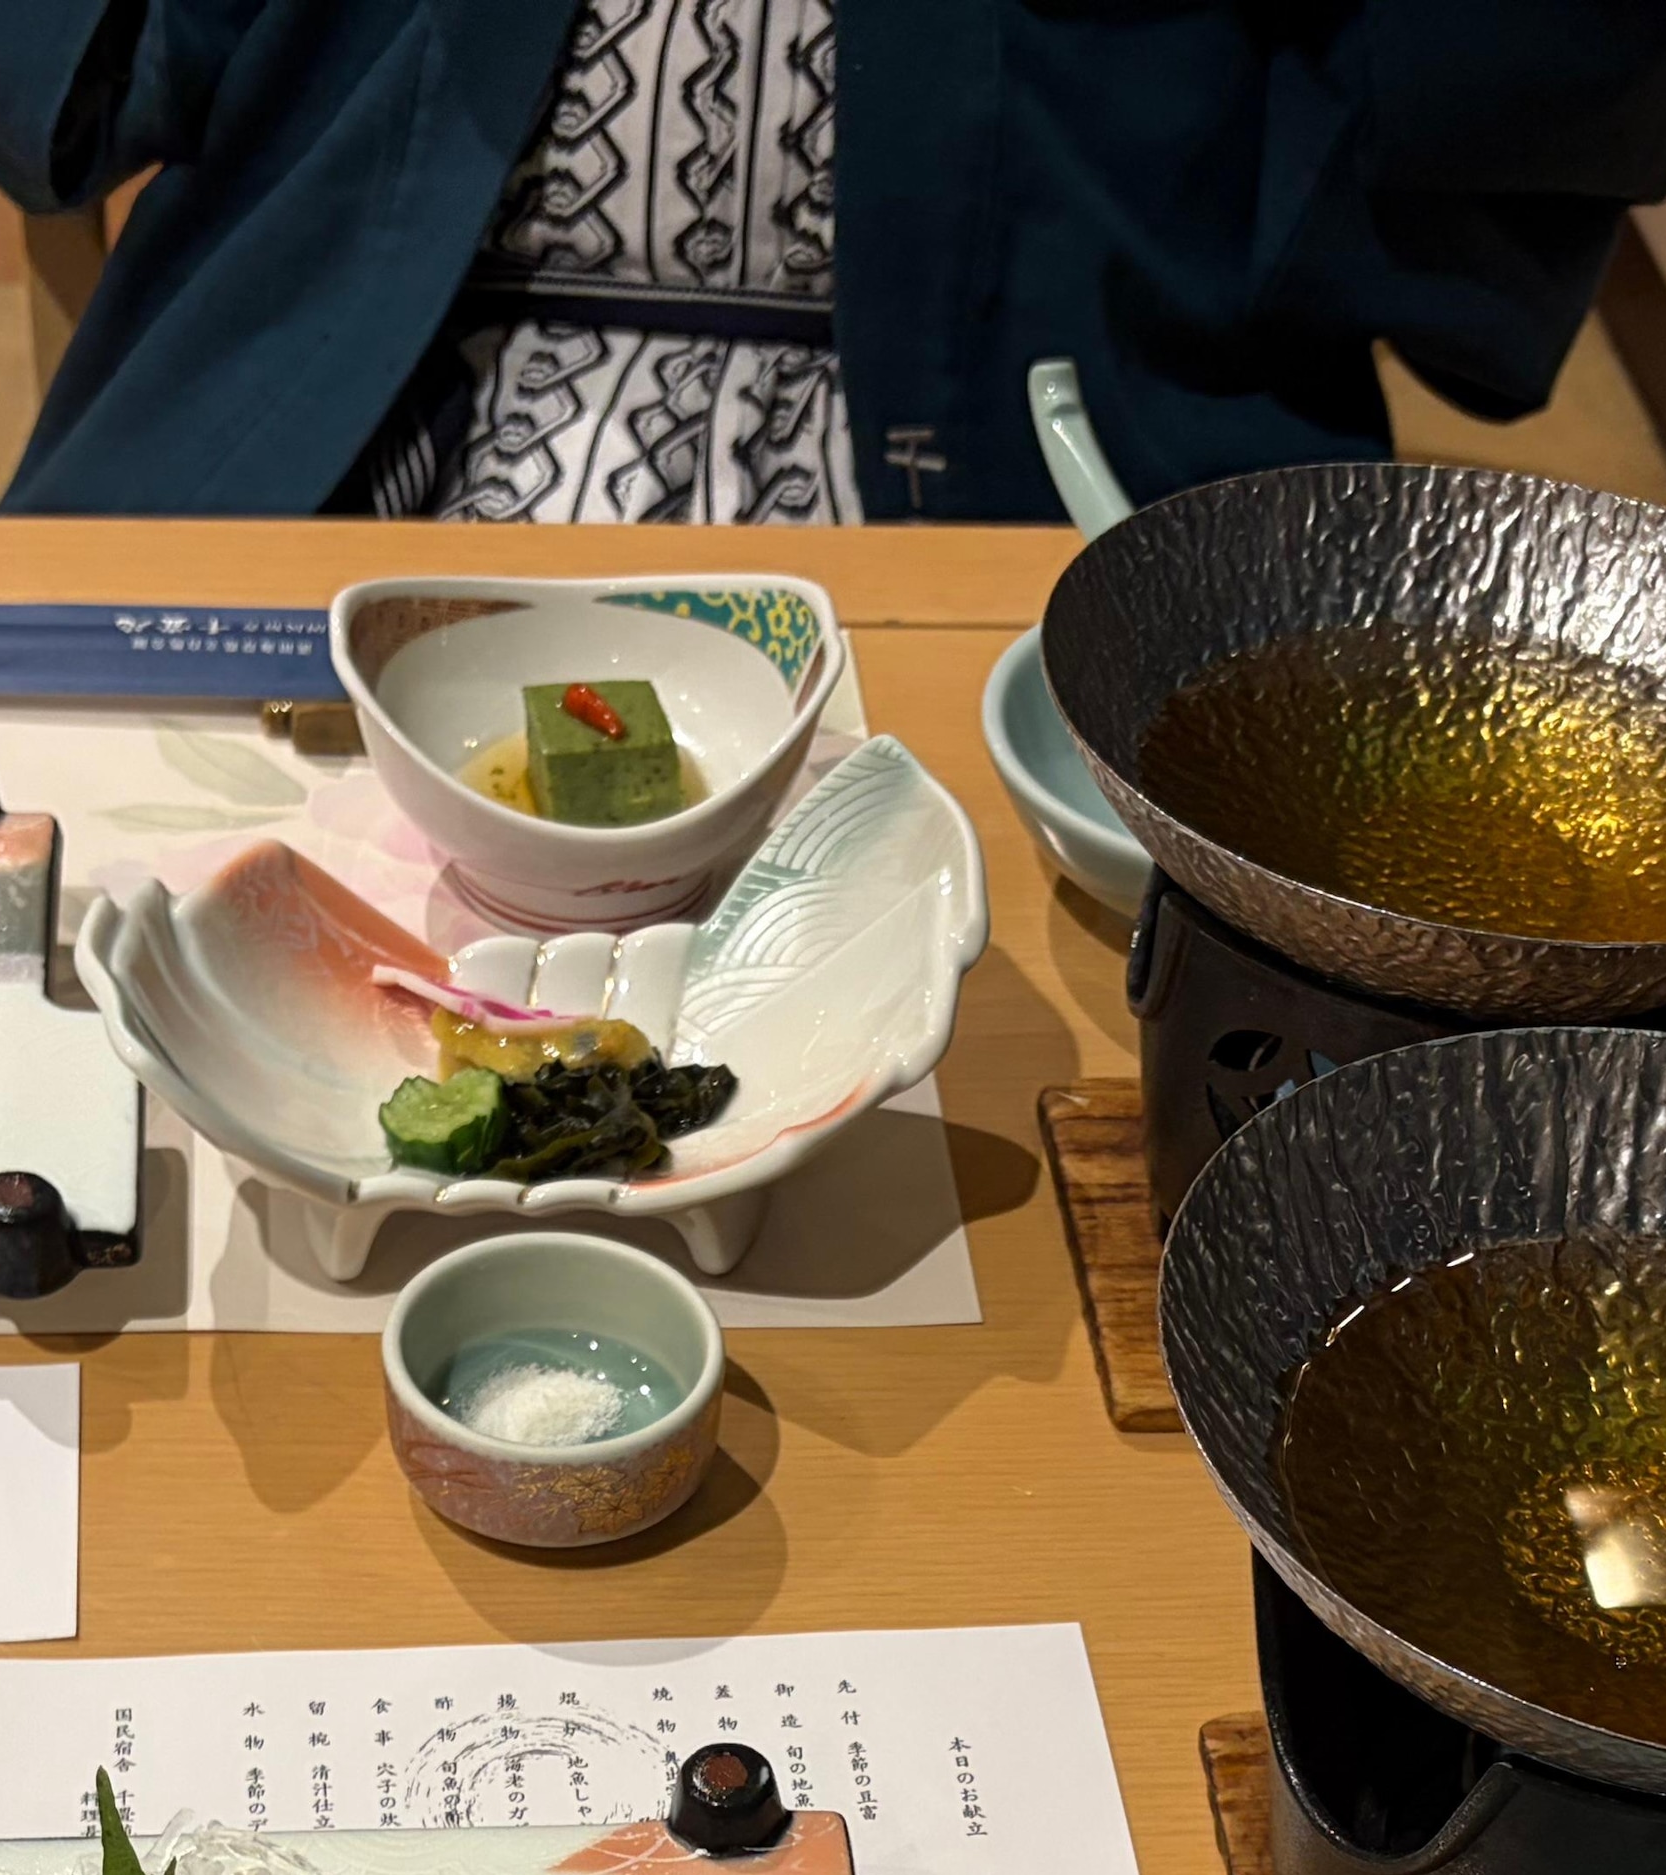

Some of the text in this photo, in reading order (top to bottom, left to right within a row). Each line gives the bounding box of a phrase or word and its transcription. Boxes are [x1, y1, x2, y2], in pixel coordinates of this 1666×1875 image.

[113, 1708, 136, 1773] 国民宿舎
[311, 1764, 335, 1829] 清汁仕立
[376, 1762, 402, 1827] 穴子の炊
[786, 1745, 815, 1808] 旬の地魚
[949, 1736, 988, 1837] 本日のお献立
